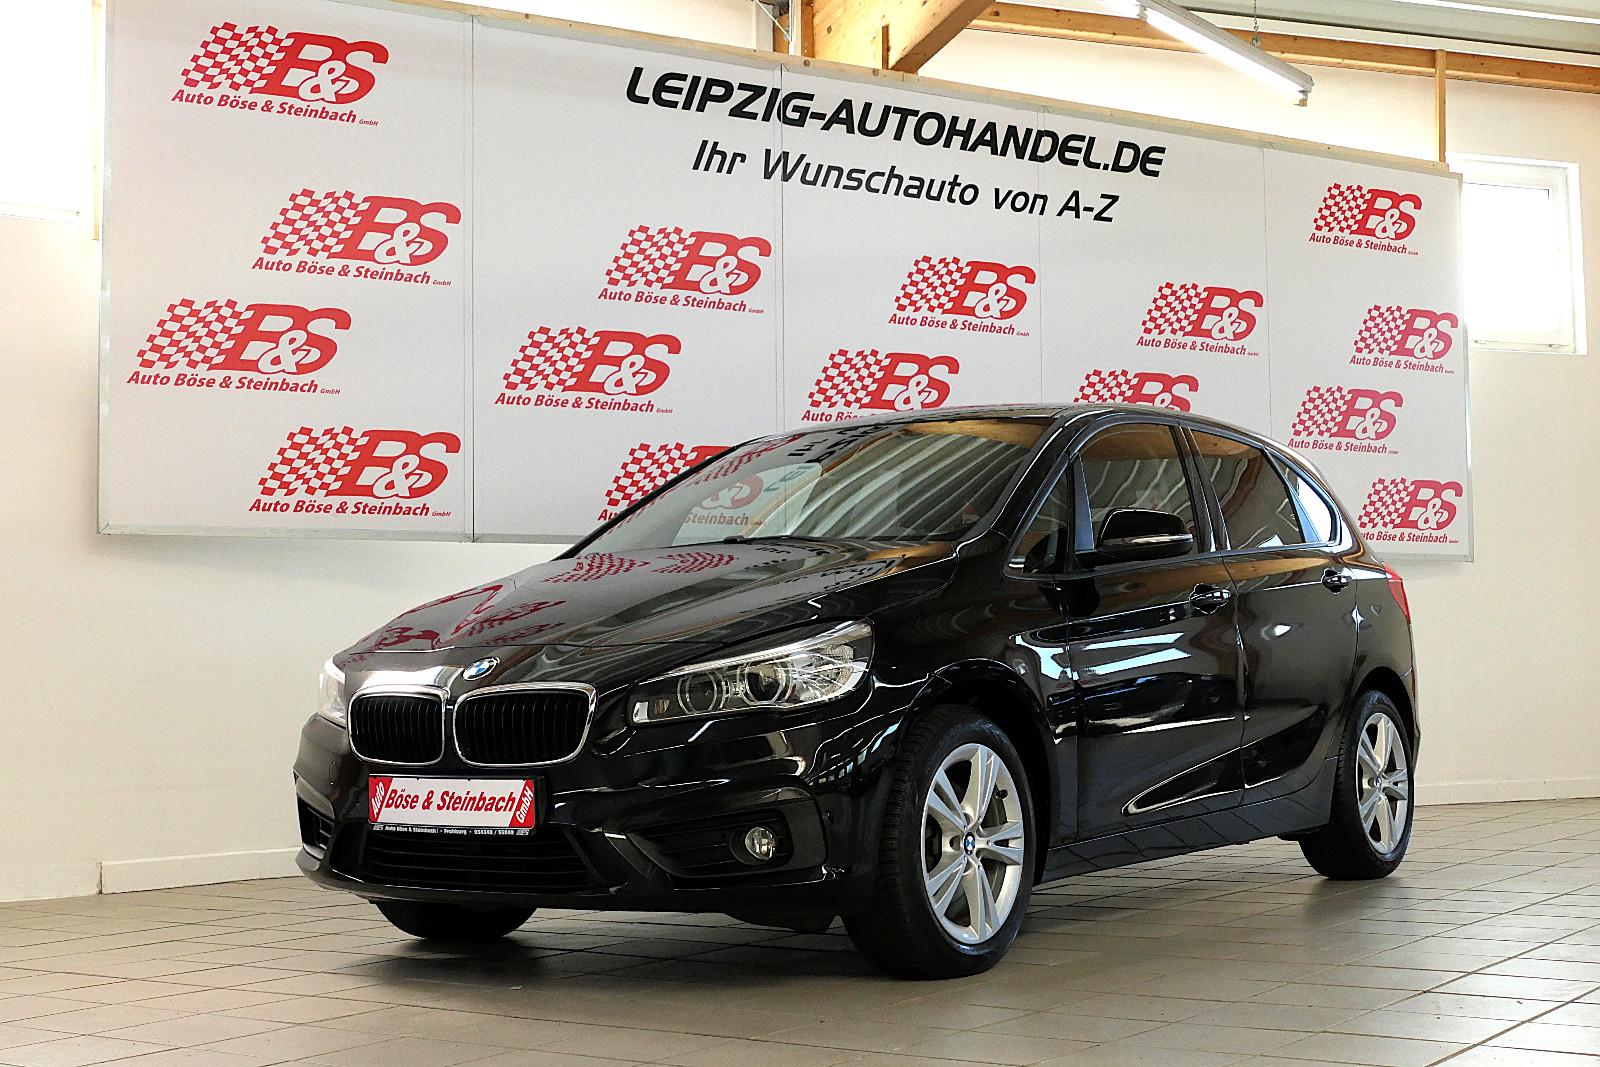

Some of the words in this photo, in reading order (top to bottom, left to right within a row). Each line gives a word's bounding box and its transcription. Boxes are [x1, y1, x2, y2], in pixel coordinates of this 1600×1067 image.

[171, 89, 214, 106] Auto
[217, 94, 258, 110] Böse
[260, 99, 275, 113] &
[276, 100, 357, 124] Steinbach
[358, 118, 379, 127] GmbH
[626, 66, 1166, 177] LEIPZIG-AUTOHANDEL.DE
[692, 139, 747, 175] Ihr
[763, 148, 979, 206] Wunschauto
[994, 187, 1048, 216] von
[1056, 189, 1120, 223] A-Z
[1309, 232, 1331, 245] Auto
[1333, 235, 1354, 248] Böse
[1356, 238, 1363, 248] &
[1364, 239, 1407, 255] Steinbach
[251, 256, 293, 272] Auto
[295, 260, 335, 276] Böse
[337, 263, 351, 277] &
[353, 265, 431, 284] Steinbach
[598, 287, 632, 302] Auto
[634, 291, 667, 305] Böse
[669, 294, 681, 306] &
[682, 295, 747, 313] Steinbach
[888, 313, 917, 326] Auto
[919, 316, 947, 329] Böse
[949, 319, 960, 330] &
[960, 319, 1015, 336] Steinbach
[1136, 336, 1161, 348] Auto
[1163, 338, 1188, 350] Böse
[1190, 341, 1198, 351] &
[1199, 341, 1247, 356] Steinbach
[1349, 354, 1371, 367] Auto
[1372, 357, 1393, 369] Böse
[1395, 360, 1402, 369] &
[1403, 361, 1444, 374] Steinbach
[127, 370, 171, 386] Auto
[173, 373, 216, 388] Böse
[218, 375, 233, 389] &
[235, 375, 318, 394] Steinbach
[495, 392, 531, 406] Auto
[534, 394, 570, 408] Böse
[572, 396, 584, 408] &
[585, 397, 655, 413] Steinbach
[801, 410, 833, 423] Auto
[835, 411, 859, 422] Bö
[1287, 438, 1310, 450] Auto
[1312, 440, 1334, 451] Böse
[1335, 442, 1343, 451] &
[1344, 442, 1387, 454] Steinbach
[249, 499, 290, 513] Auto
[293, 499, 333, 514] Böse
[335, 501, 349, 514] &
[351, 501, 430, 517] Steinbach
[1376, 531, 1396, 542] Böse
[1398, 533, 1406, 542] &
[1406, 533, 1448, 544] Steinbach
[371, 781, 385, 818] Auto
[385, 788, 419, 810] Böse
[422, 789, 435, 810] &
[436, 790, 516, 812] Steinbach
[515, 786, 534, 824] GmbH
